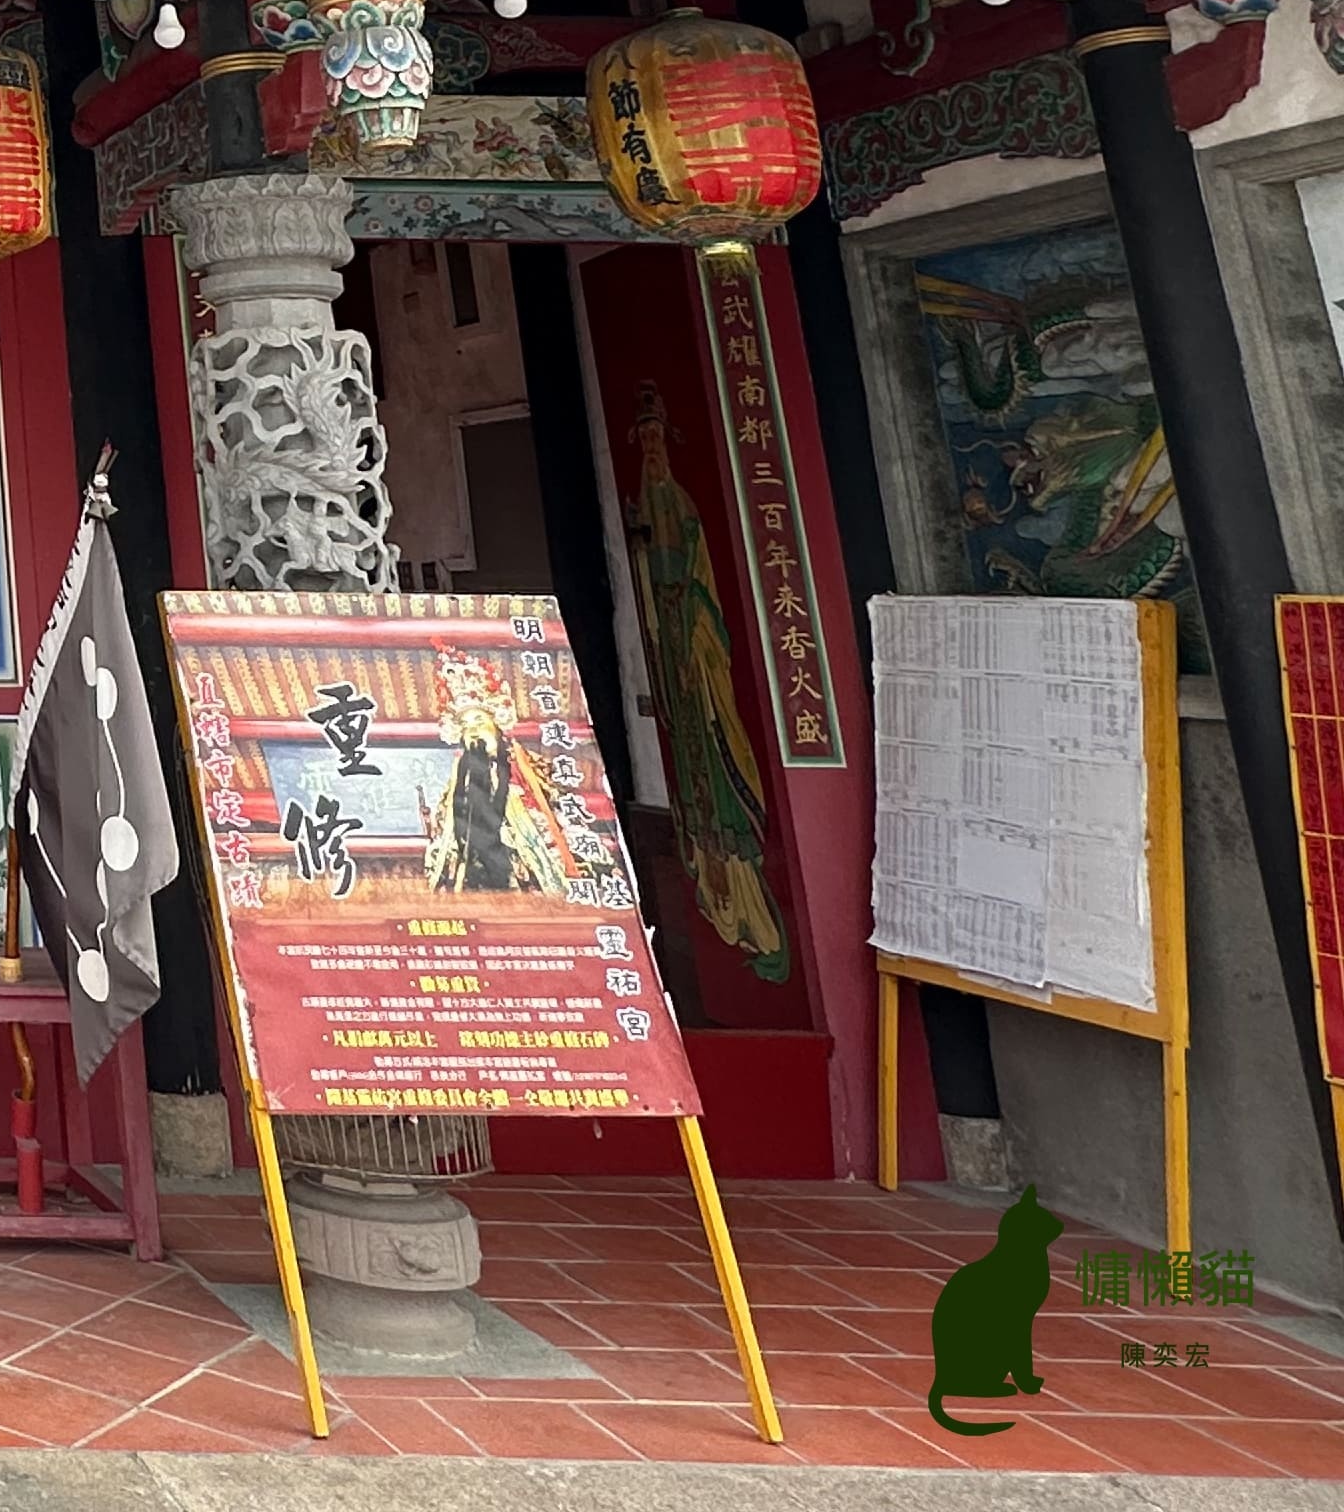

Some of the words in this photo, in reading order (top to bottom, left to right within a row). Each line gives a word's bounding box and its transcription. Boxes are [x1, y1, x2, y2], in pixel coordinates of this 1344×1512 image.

[603, 38, 681, 207] 八節有慶
[720, 259, 828, 745] 武耀南都三百年來香火盛
[190, 672, 265, 910] 直轄市定古蹟
[279, 683, 383, 899] 重修
[597, 926, 650, 1042] 靈祐宮
